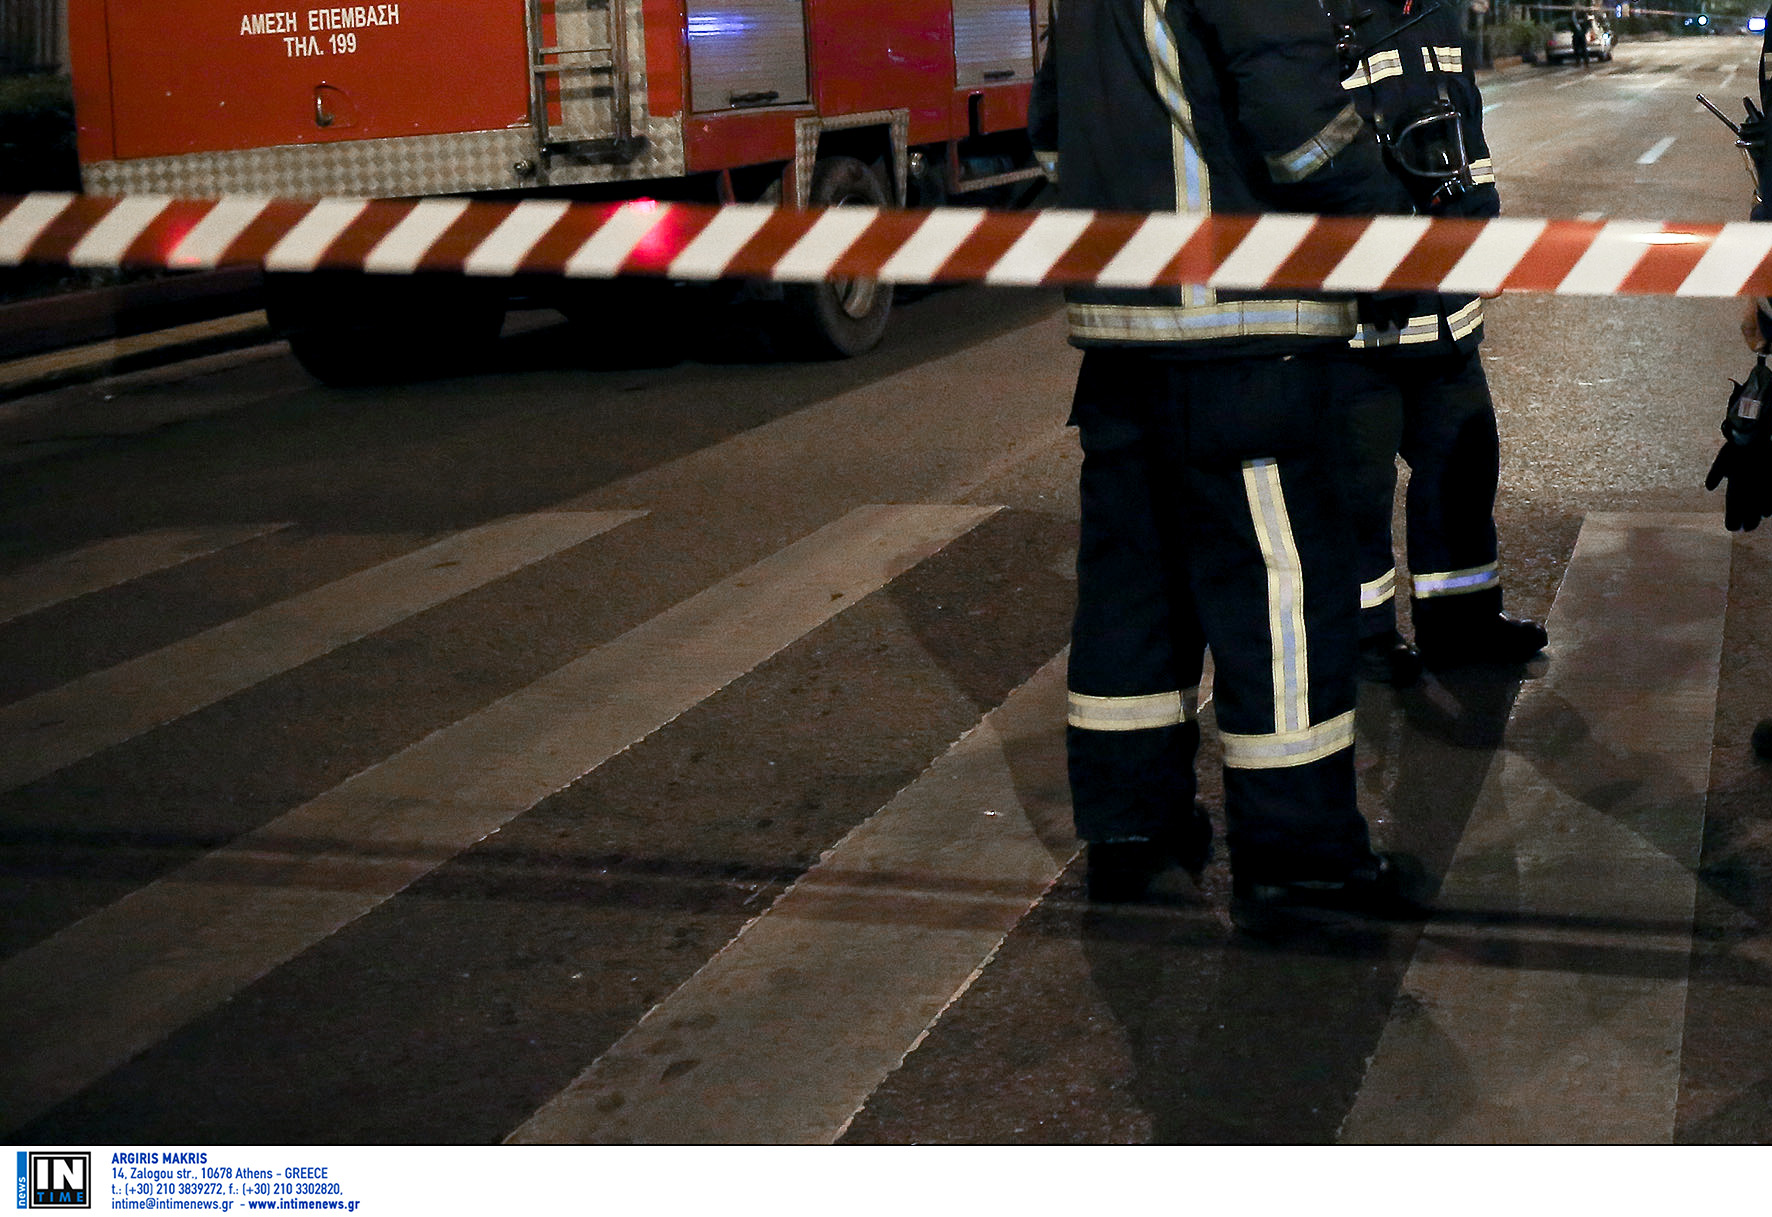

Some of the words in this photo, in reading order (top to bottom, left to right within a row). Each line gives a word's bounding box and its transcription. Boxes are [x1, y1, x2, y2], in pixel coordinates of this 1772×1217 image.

[240, 12, 298, 36] ΑΜΕΣΗ
[308, 3, 400, 32] ΕΠΕΜΒΑΣΗ
[283, 35, 325, 58] ΤΗΛ.
[328, 32, 357, 55] 199
